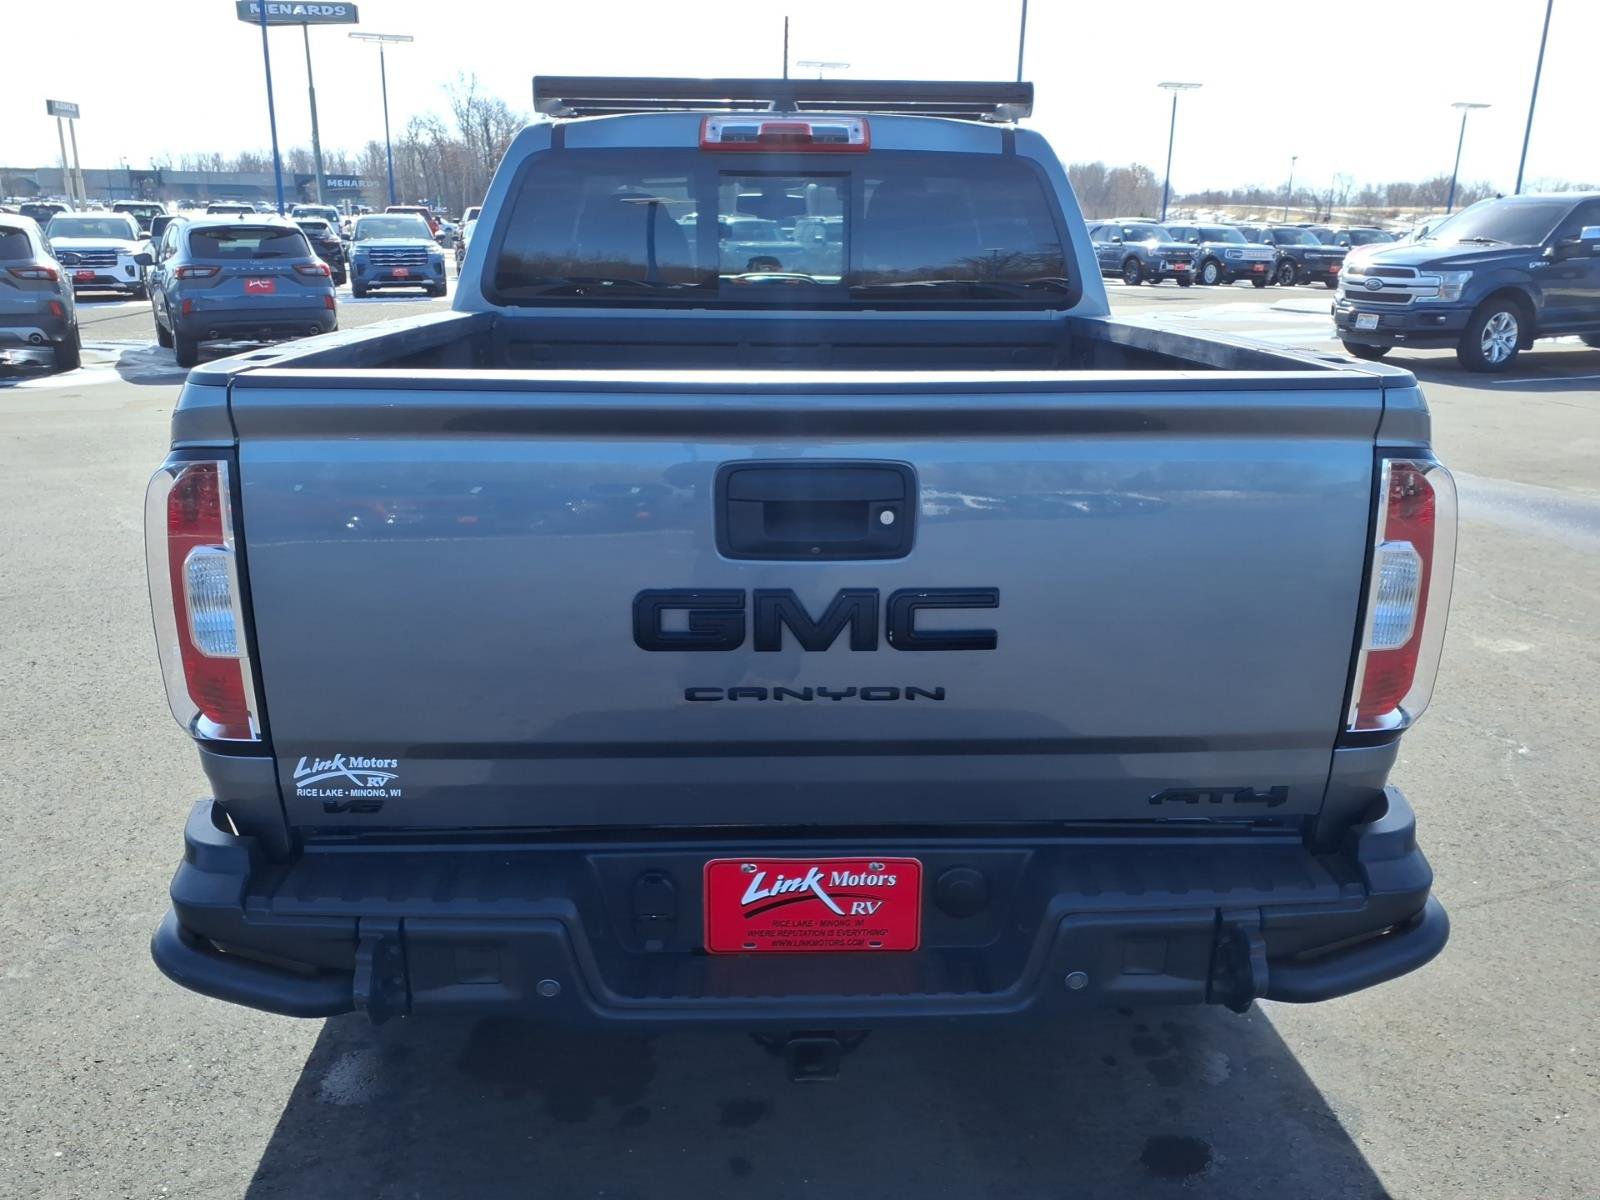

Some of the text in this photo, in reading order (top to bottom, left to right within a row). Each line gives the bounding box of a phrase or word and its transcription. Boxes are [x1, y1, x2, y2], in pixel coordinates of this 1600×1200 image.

[249, 3, 346, 16] MENARDS
[631, 586, 1000, 652] GMC
[684, 686, 946, 701] CANYON
[293, 753, 398, 786] Link Motors
[366, 777, 389, 787] RV
[296, 788, 401, 798] RICE LAKE MINONG, WI
[1148, 785, 1289, 808] AT4
[741, 866, 897, 916] Link Motors
[850, 901, 883, 916] RV
[772, 919, 791, 928] RICE
[792, 919, 813, 928] LAKE
[854, 919, 865, 927] WI
[776, 929, 826, 937] REPUTATION
